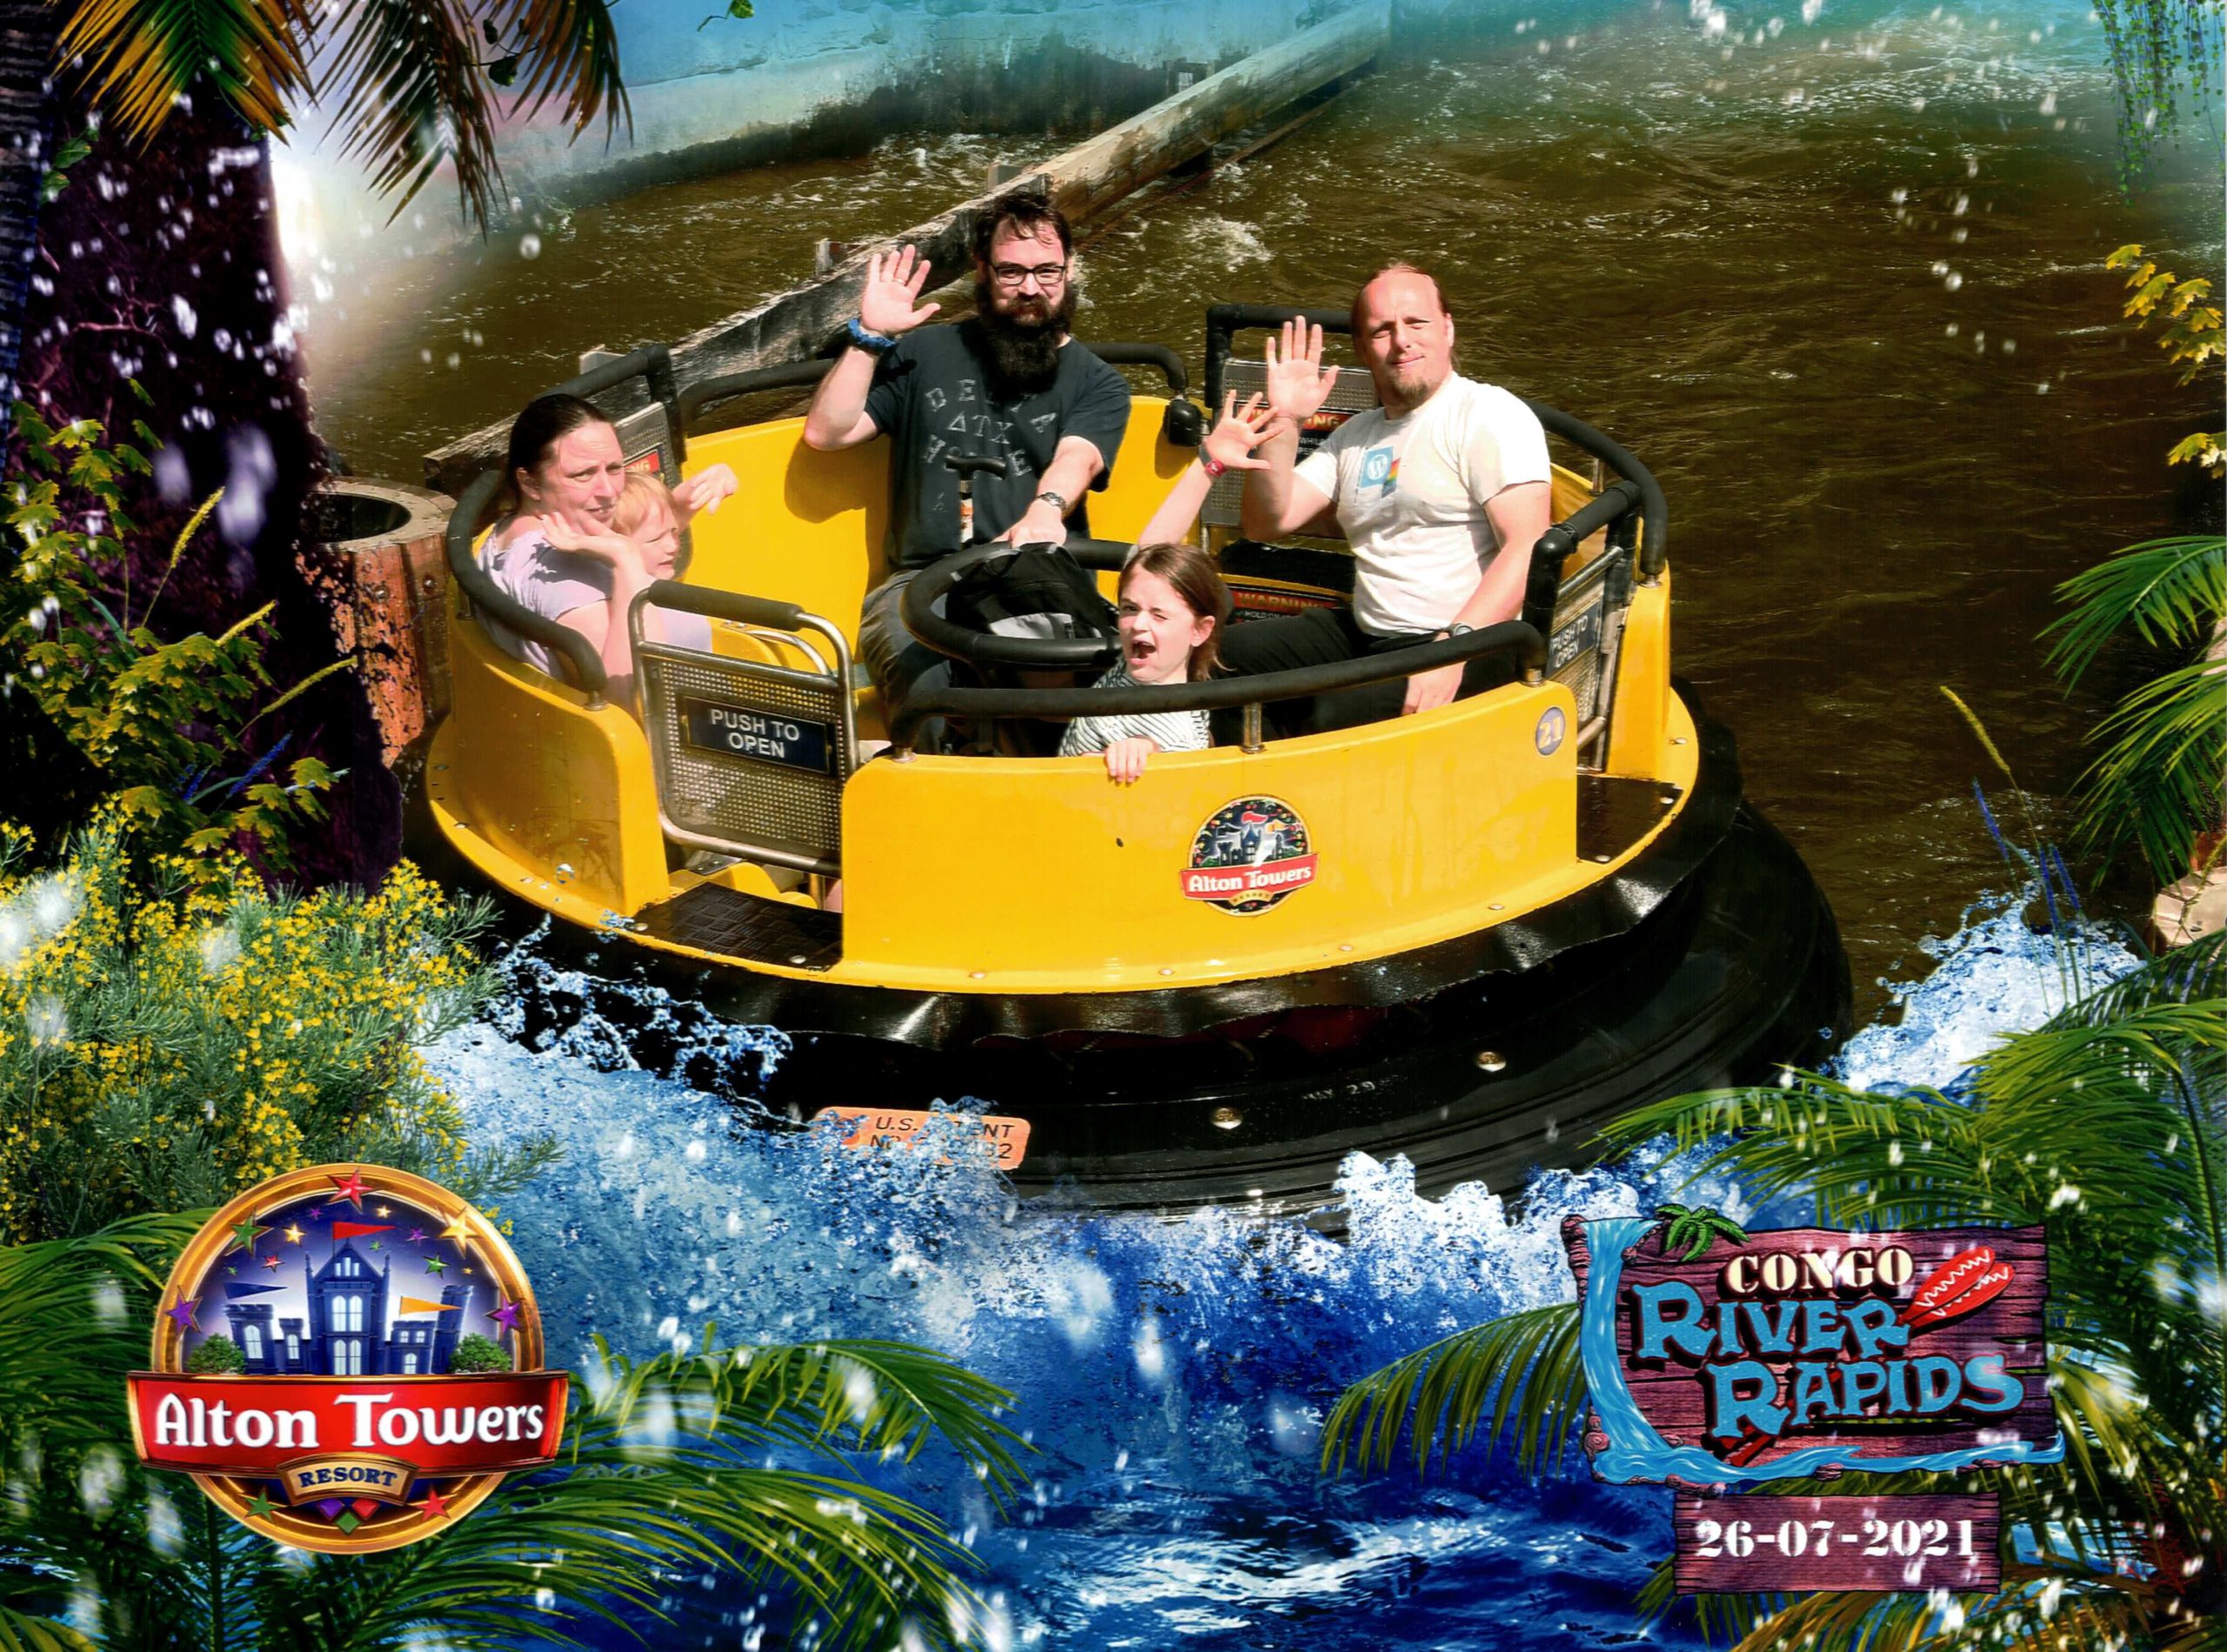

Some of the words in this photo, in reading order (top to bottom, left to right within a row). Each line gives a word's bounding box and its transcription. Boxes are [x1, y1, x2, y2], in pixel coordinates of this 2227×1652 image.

[1551, 627, 1575, 653] PUSH
[1577, 615, 1588, 635] TO
[1555, 639, 1579, 668] OPEN
[710, 708, 766, 736] PUSH
[771, 720, 800, 741] TO
[1539, 716, 1562, 749] 21
[727, 732, 786, 759] OPEN
[1189, 874, 1243, 893] Alton
[1243, 866, 1312, 888] Towers
[875, 1116, 919, 1132] U.S.
